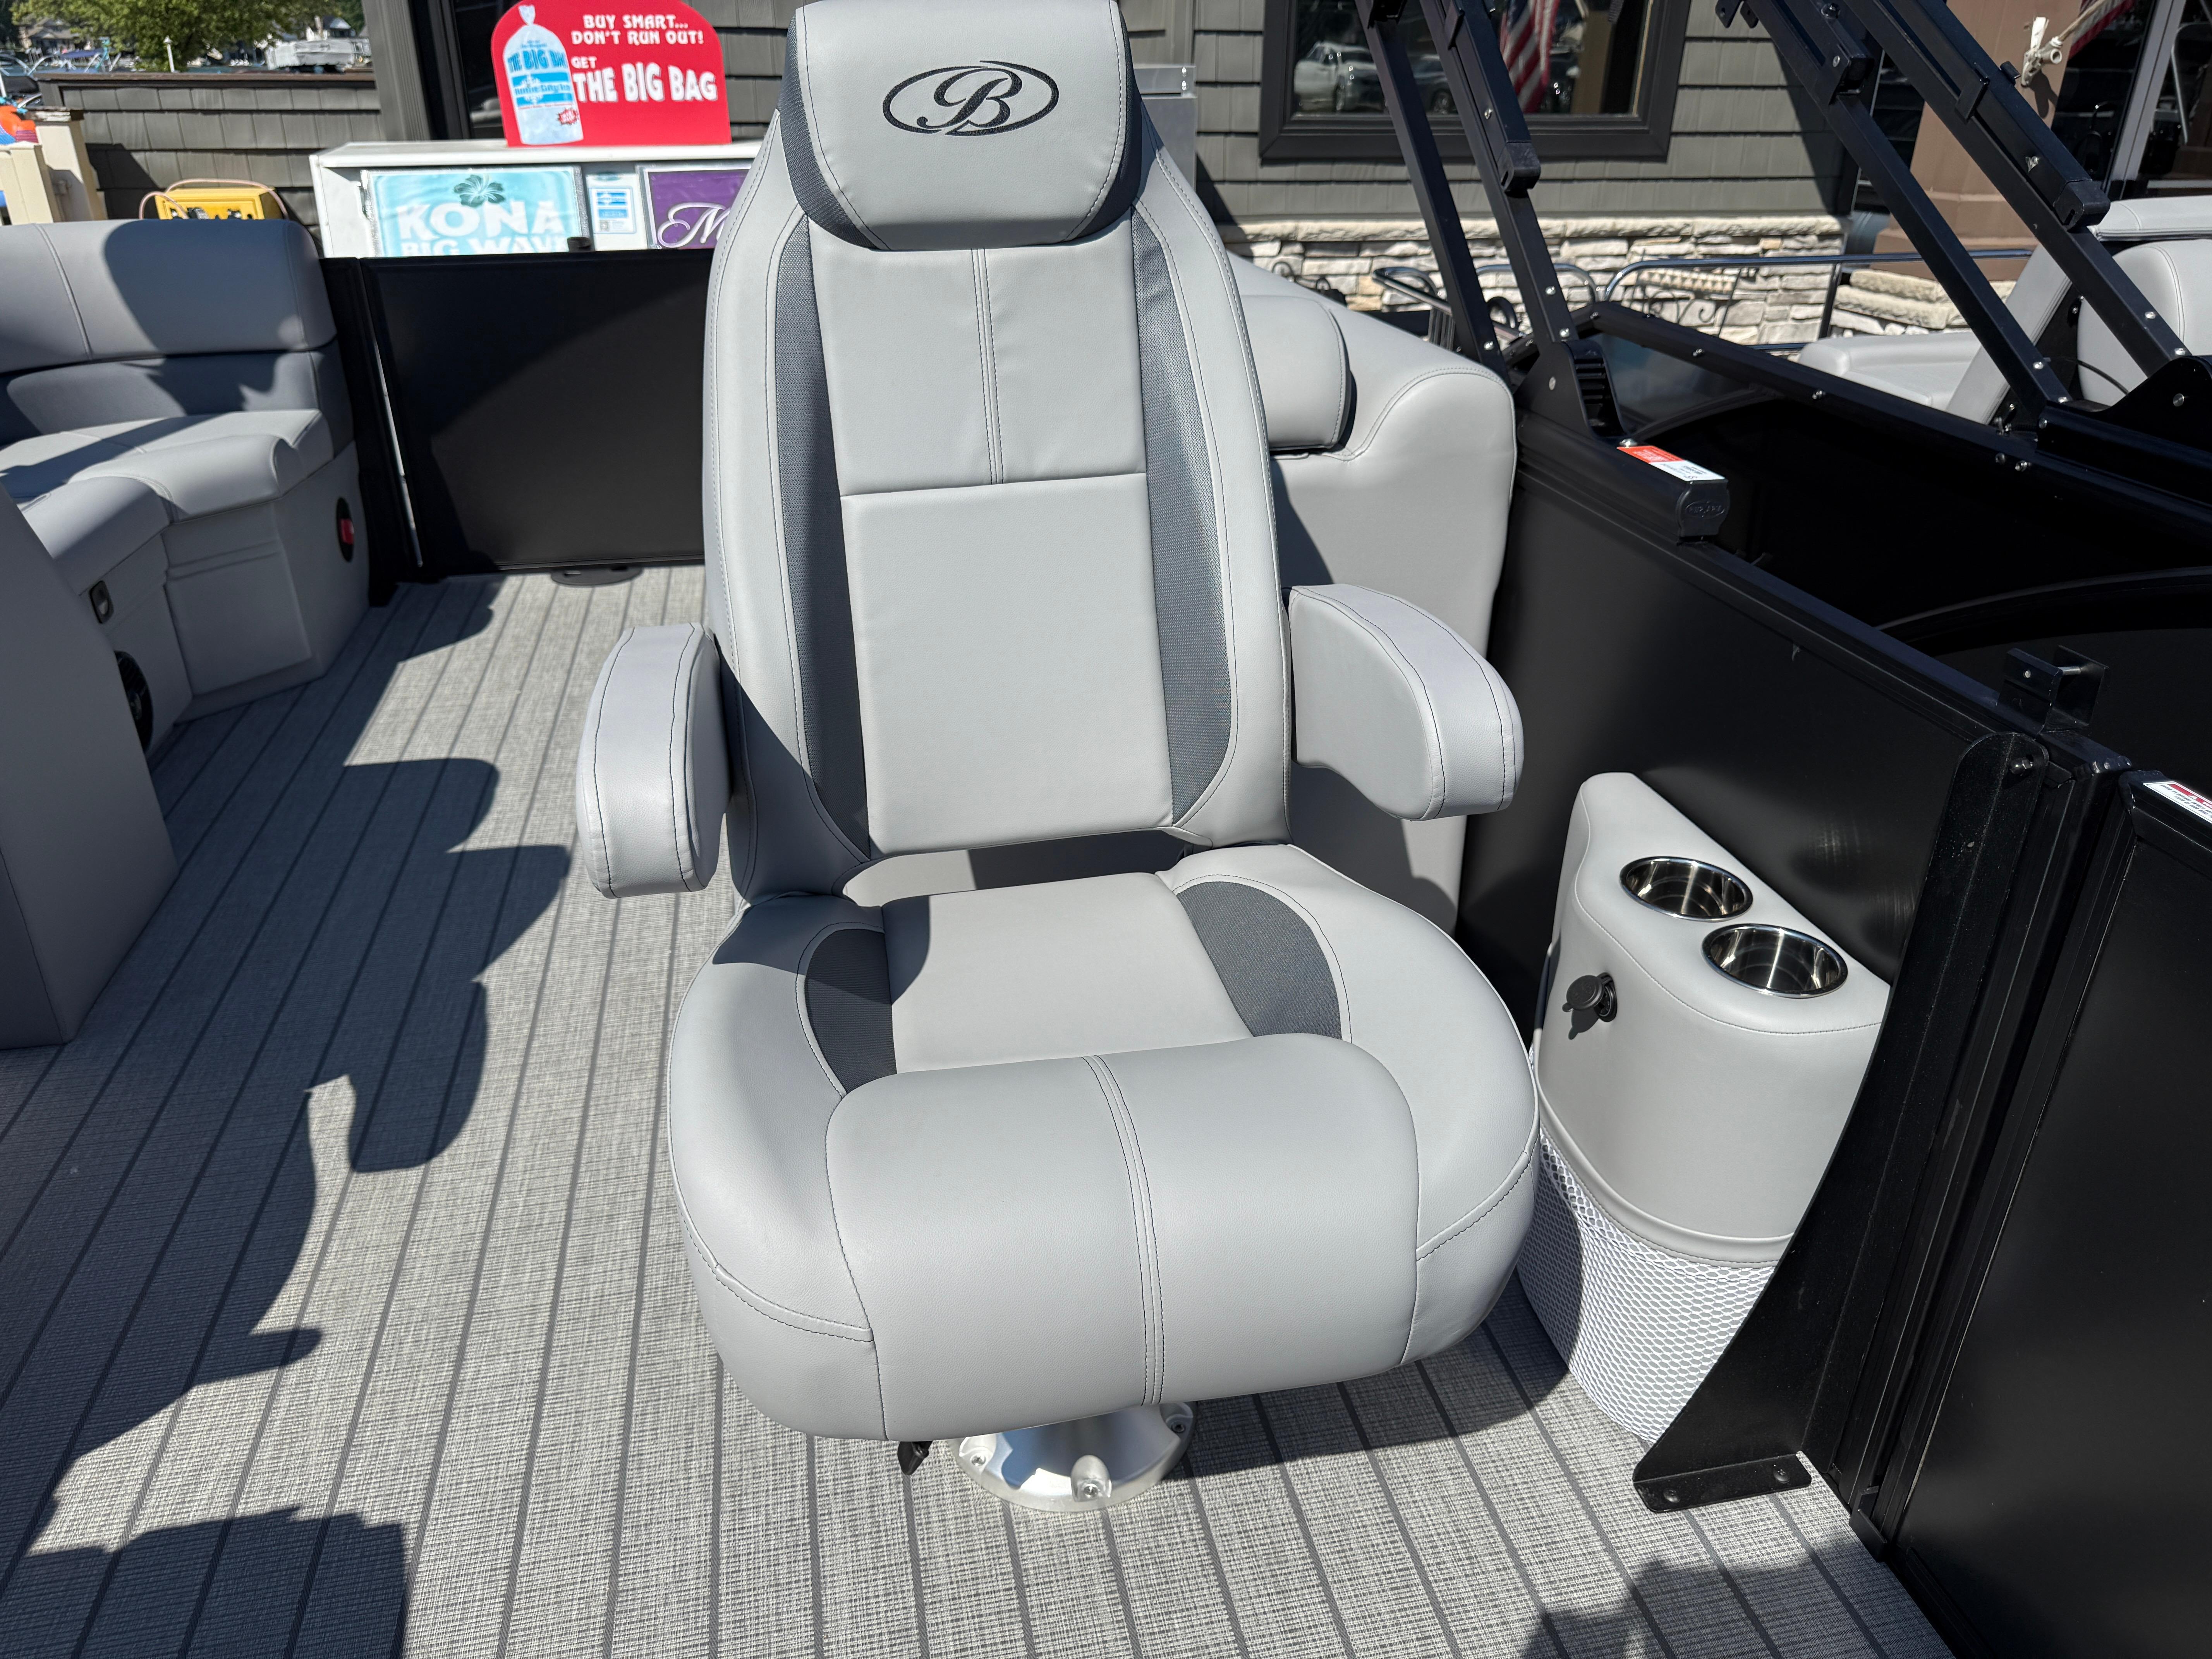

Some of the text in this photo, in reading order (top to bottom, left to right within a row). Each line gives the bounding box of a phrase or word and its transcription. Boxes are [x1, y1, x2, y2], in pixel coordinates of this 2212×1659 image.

[583, 14, 688, 29] BUY SMART...
[571, 30, 704, 46] DON'T RUN OUT!
[523, 49, 549, 70] BIG
[571, 56, 597, 69] GET
[572, 62, 718, 103] THE BIG BAG
[396, 201, 565, 240] KONA
